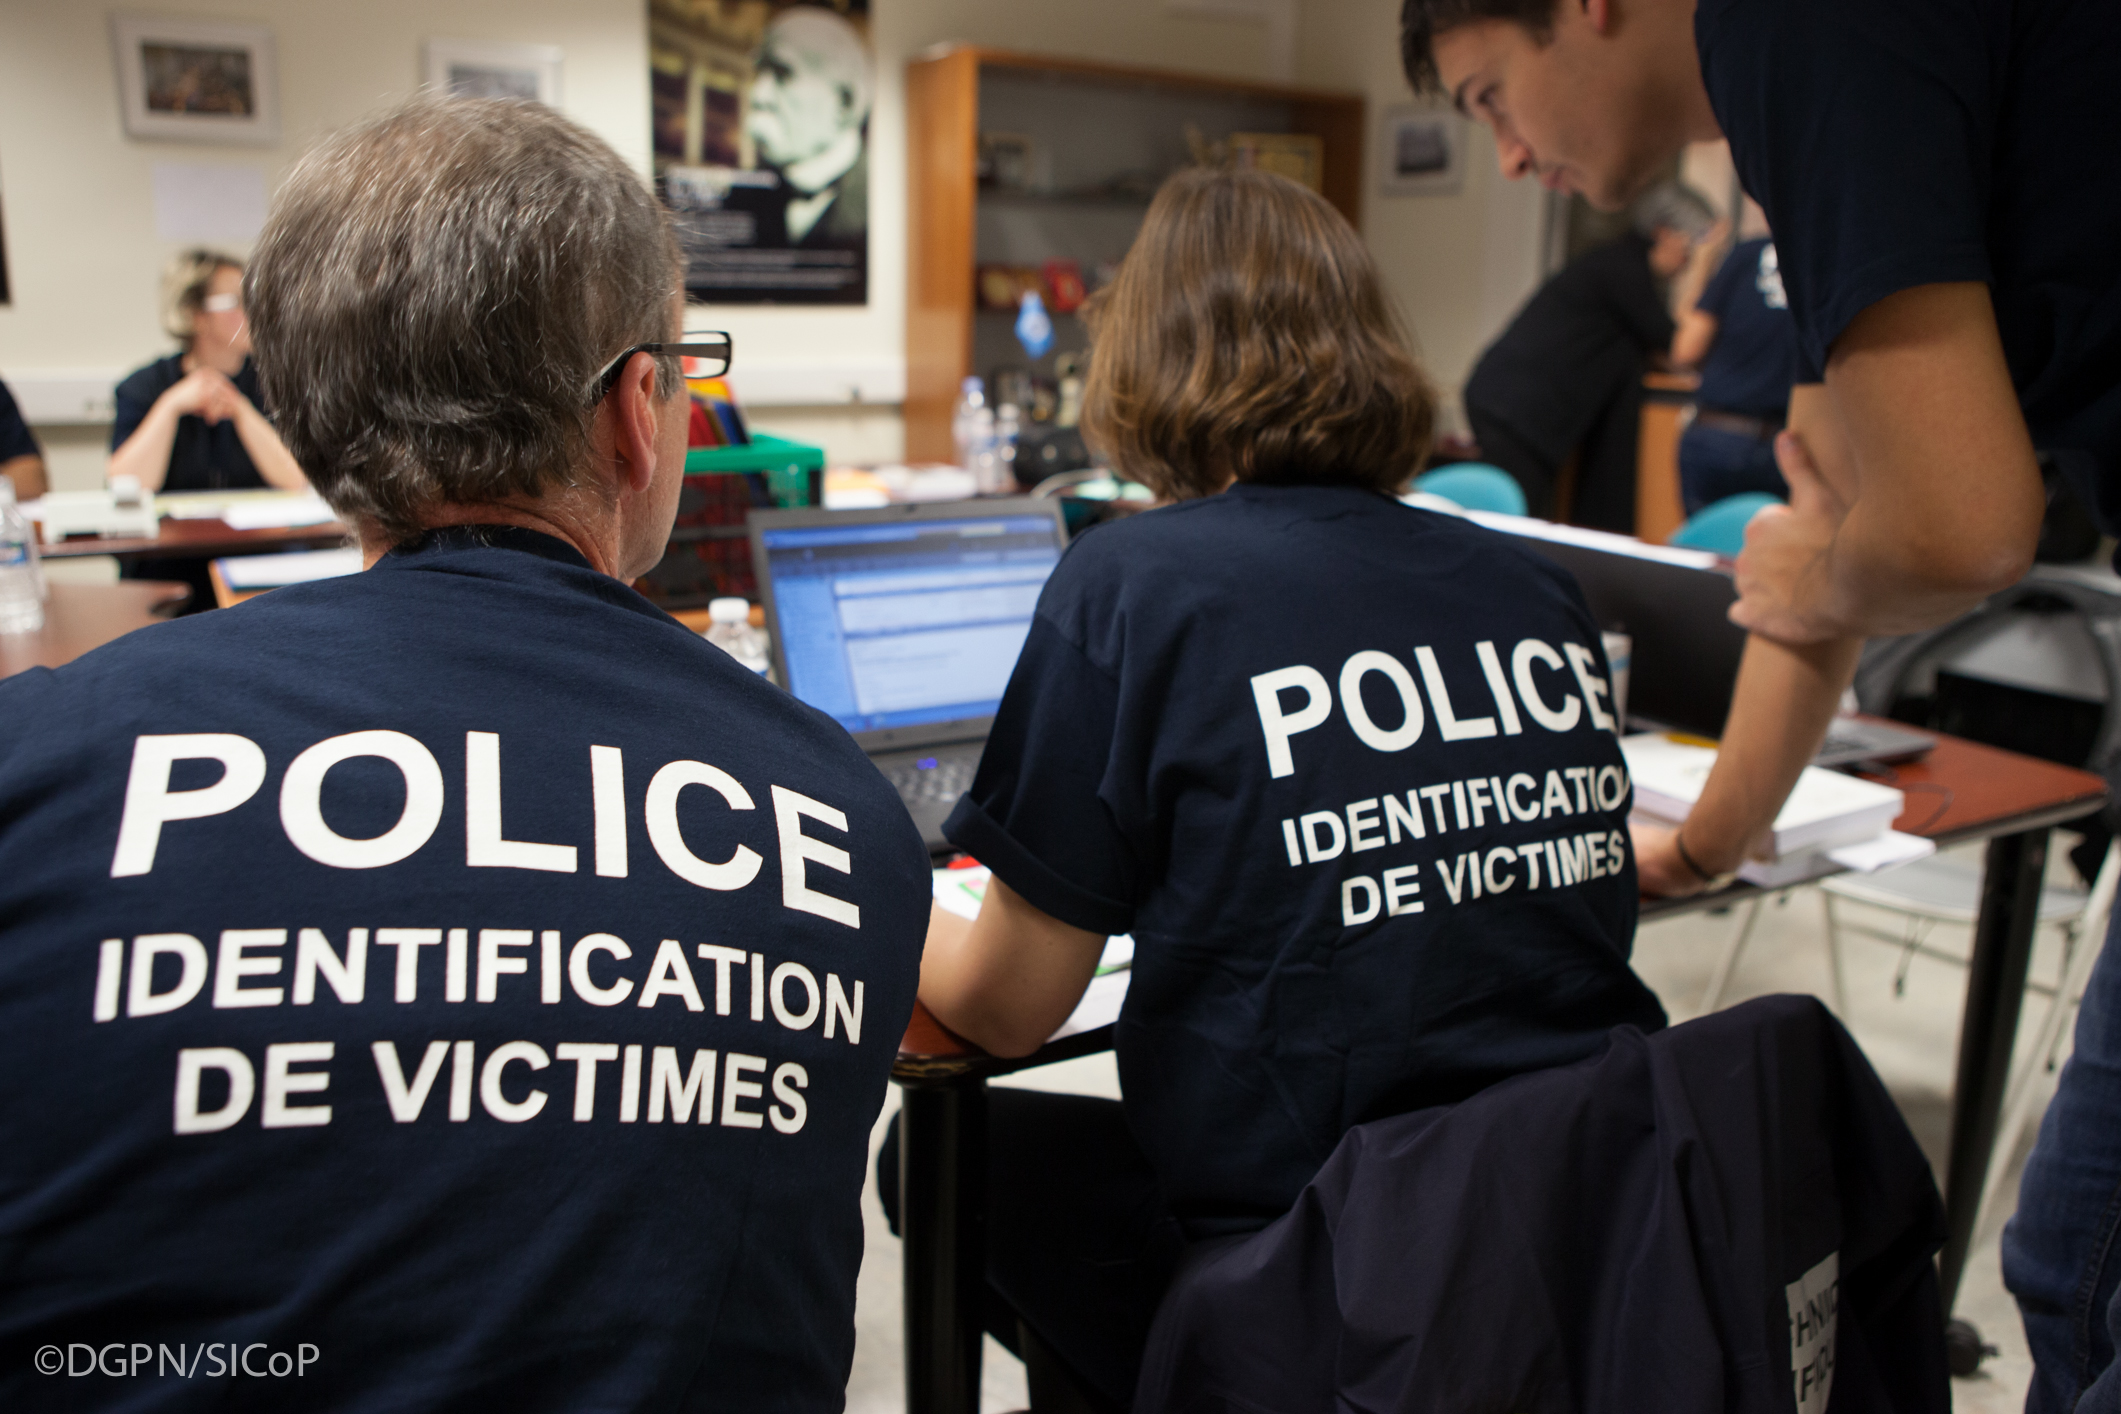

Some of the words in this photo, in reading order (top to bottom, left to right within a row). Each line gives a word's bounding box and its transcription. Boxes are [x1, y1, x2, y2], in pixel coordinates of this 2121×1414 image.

[1250, 638, 1617, 779] POLICE
[110, 729, 861, 929] POLICE
[1342, 864, 1425, 927] DE
[1435, 830, 1625, 905] VICTIMES
[94, 927, 864, 1045] IDENTIFICATION
[174, 1041, 335, 1134] DE
[372, 1040, 809, 1134] VICTIMES
